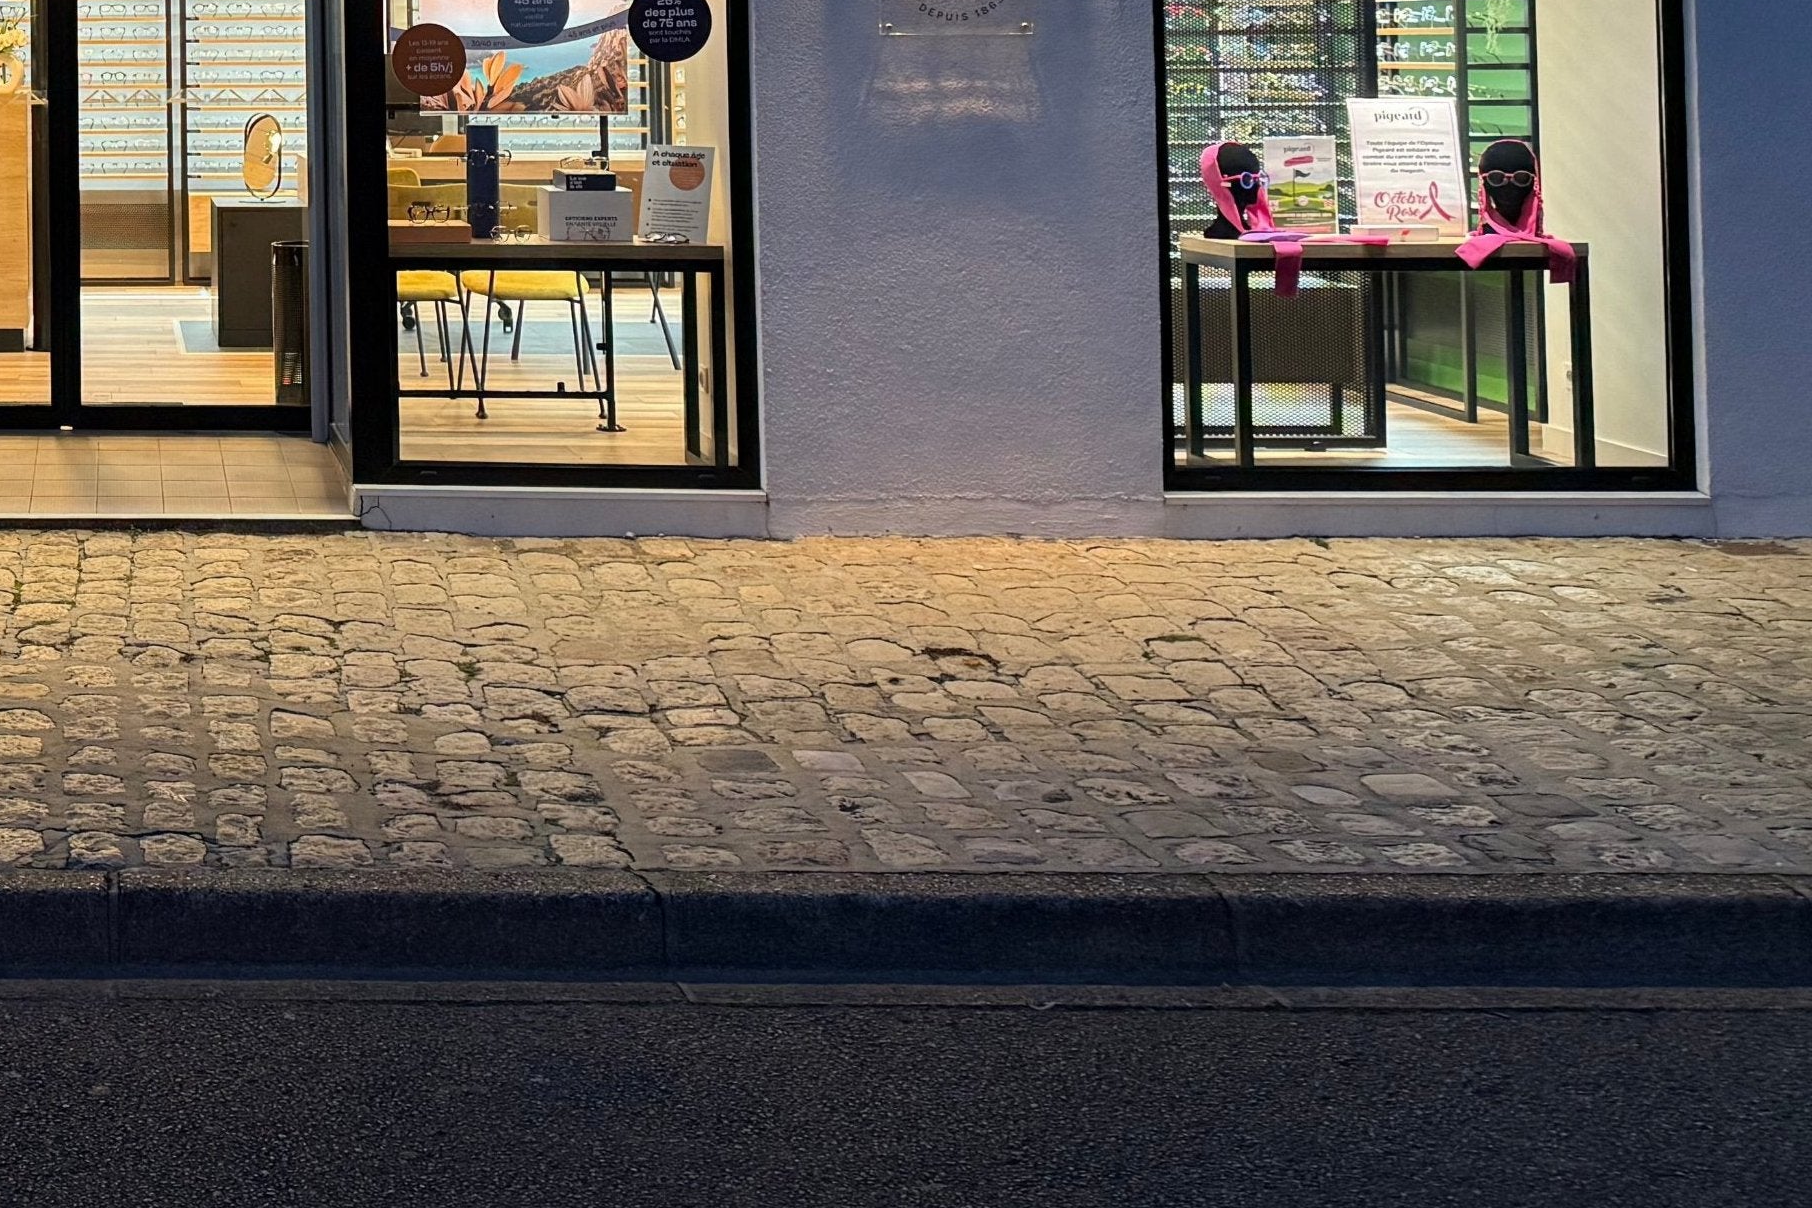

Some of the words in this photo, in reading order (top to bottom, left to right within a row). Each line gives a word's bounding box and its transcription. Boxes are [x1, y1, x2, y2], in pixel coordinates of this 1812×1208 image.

[644, 7, 666, 17] des
[668, 6, 695, 18] plus
[918, 3, 969, 21] DEPUIS
[642, 19, 658, 28] de
[659, 18, 674, 28] 75
[676, 19, 698, 28] ans
[413, 63, 428, 72] de
[1374, 190, 1428, 208] Octobre
[1386, 204, 1421, 223] Rose
